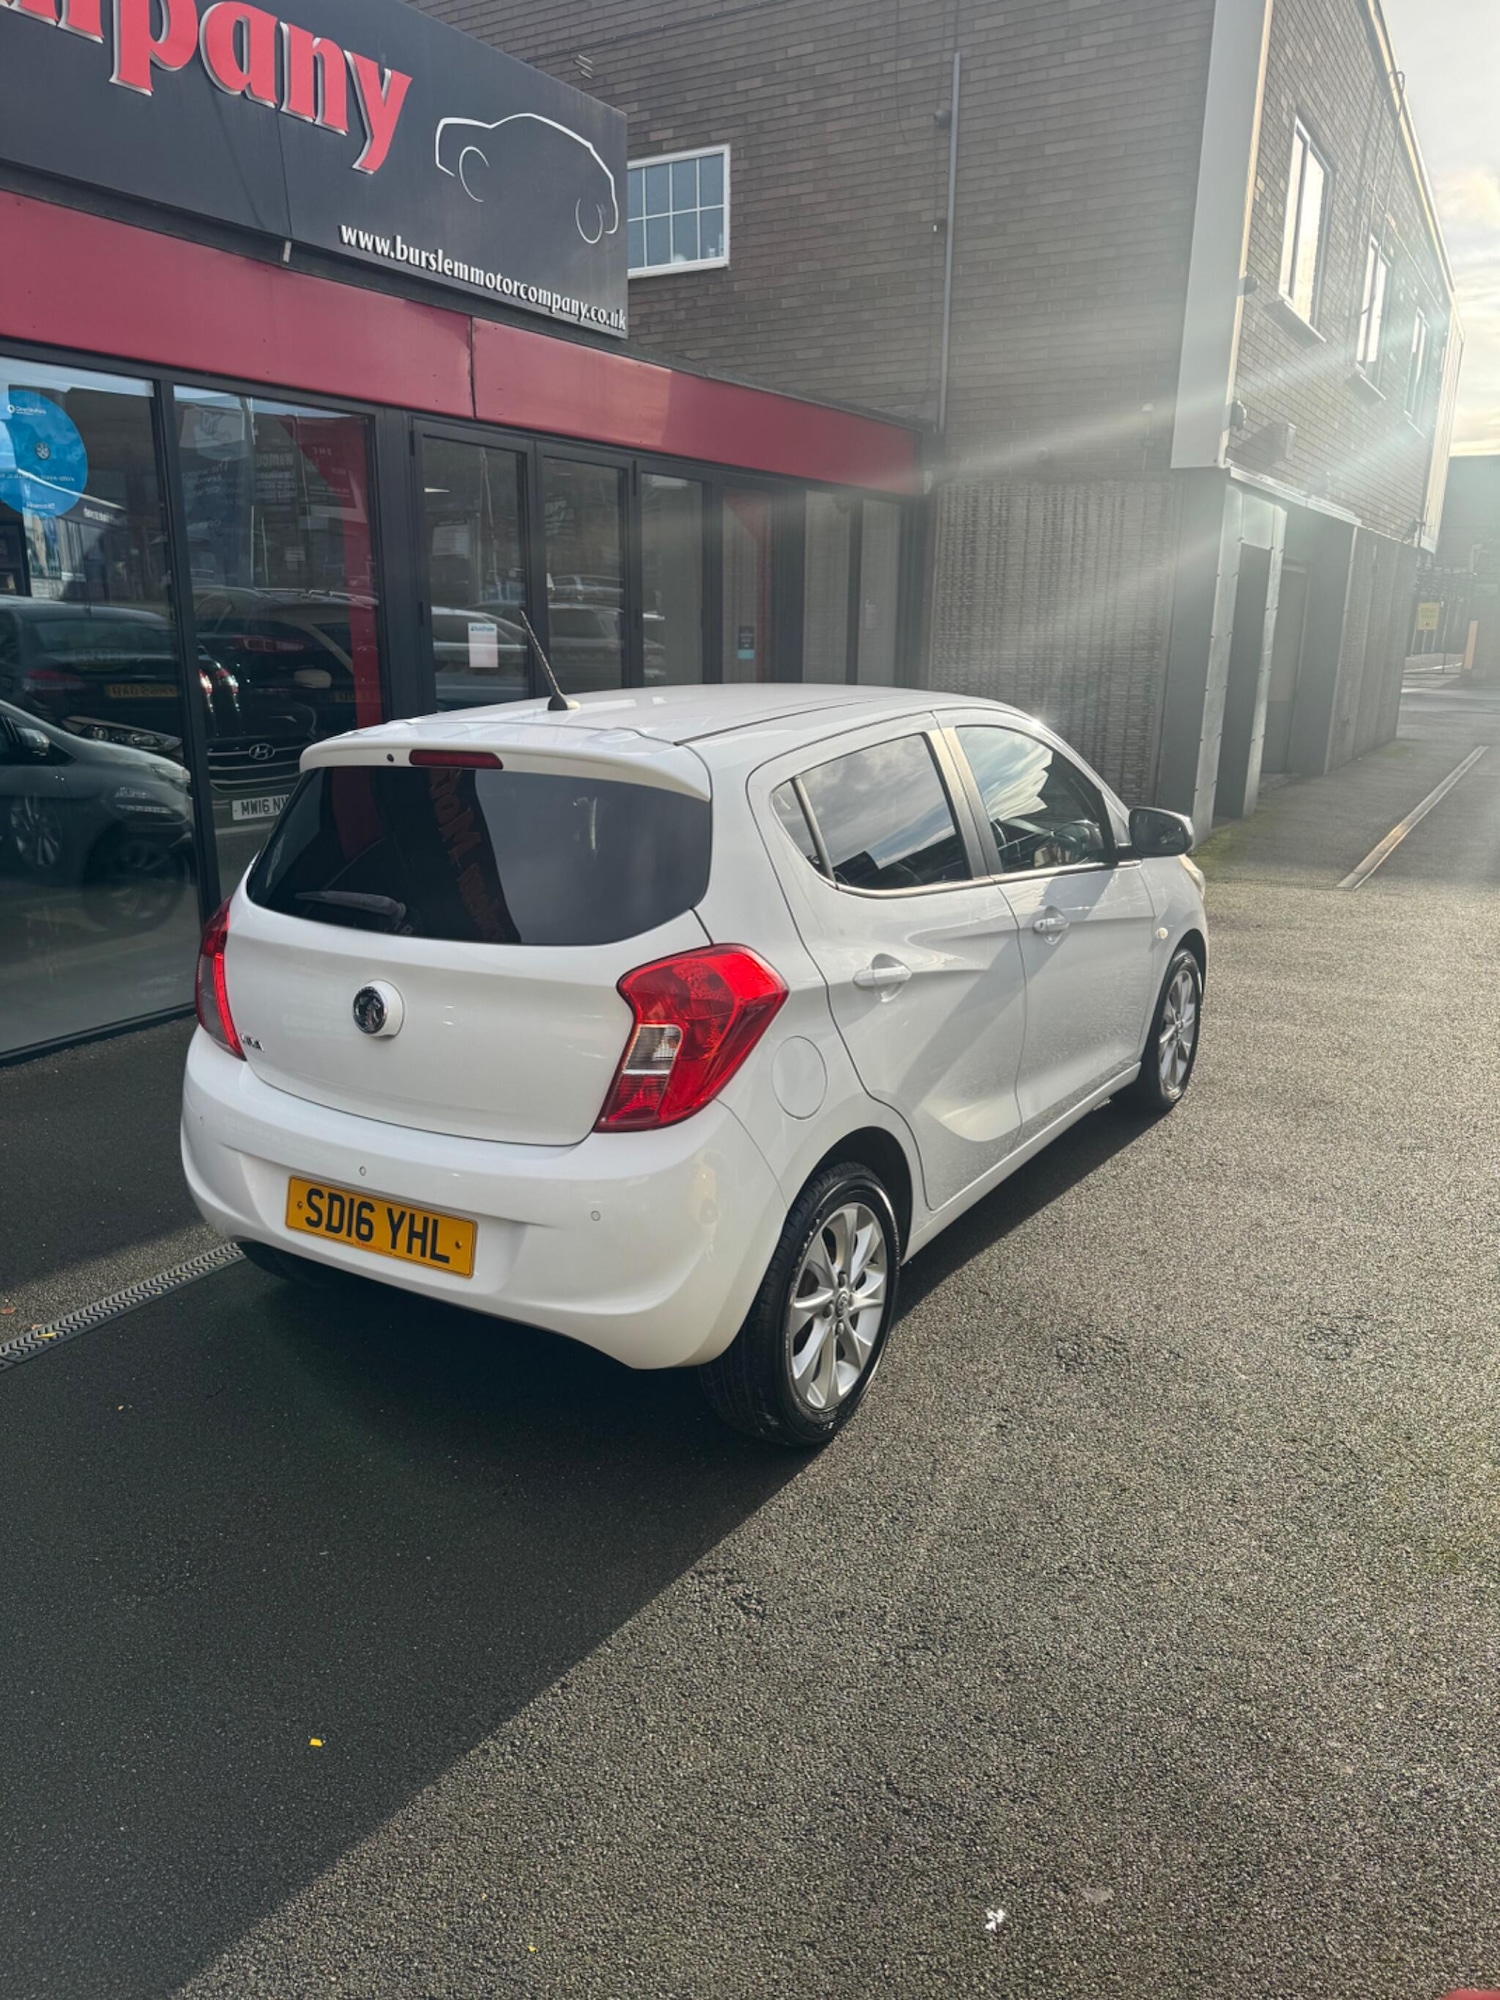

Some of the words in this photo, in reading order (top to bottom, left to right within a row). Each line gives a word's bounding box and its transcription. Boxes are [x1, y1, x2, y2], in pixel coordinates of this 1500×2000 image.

[338, 224, 627, 331] www.burslemmotorcompany.co.uk
[241, 799, 270, 816] MW16
[305, 1188, 375, 1242] SD16
[387, 1207, 450, 1264] YHL
